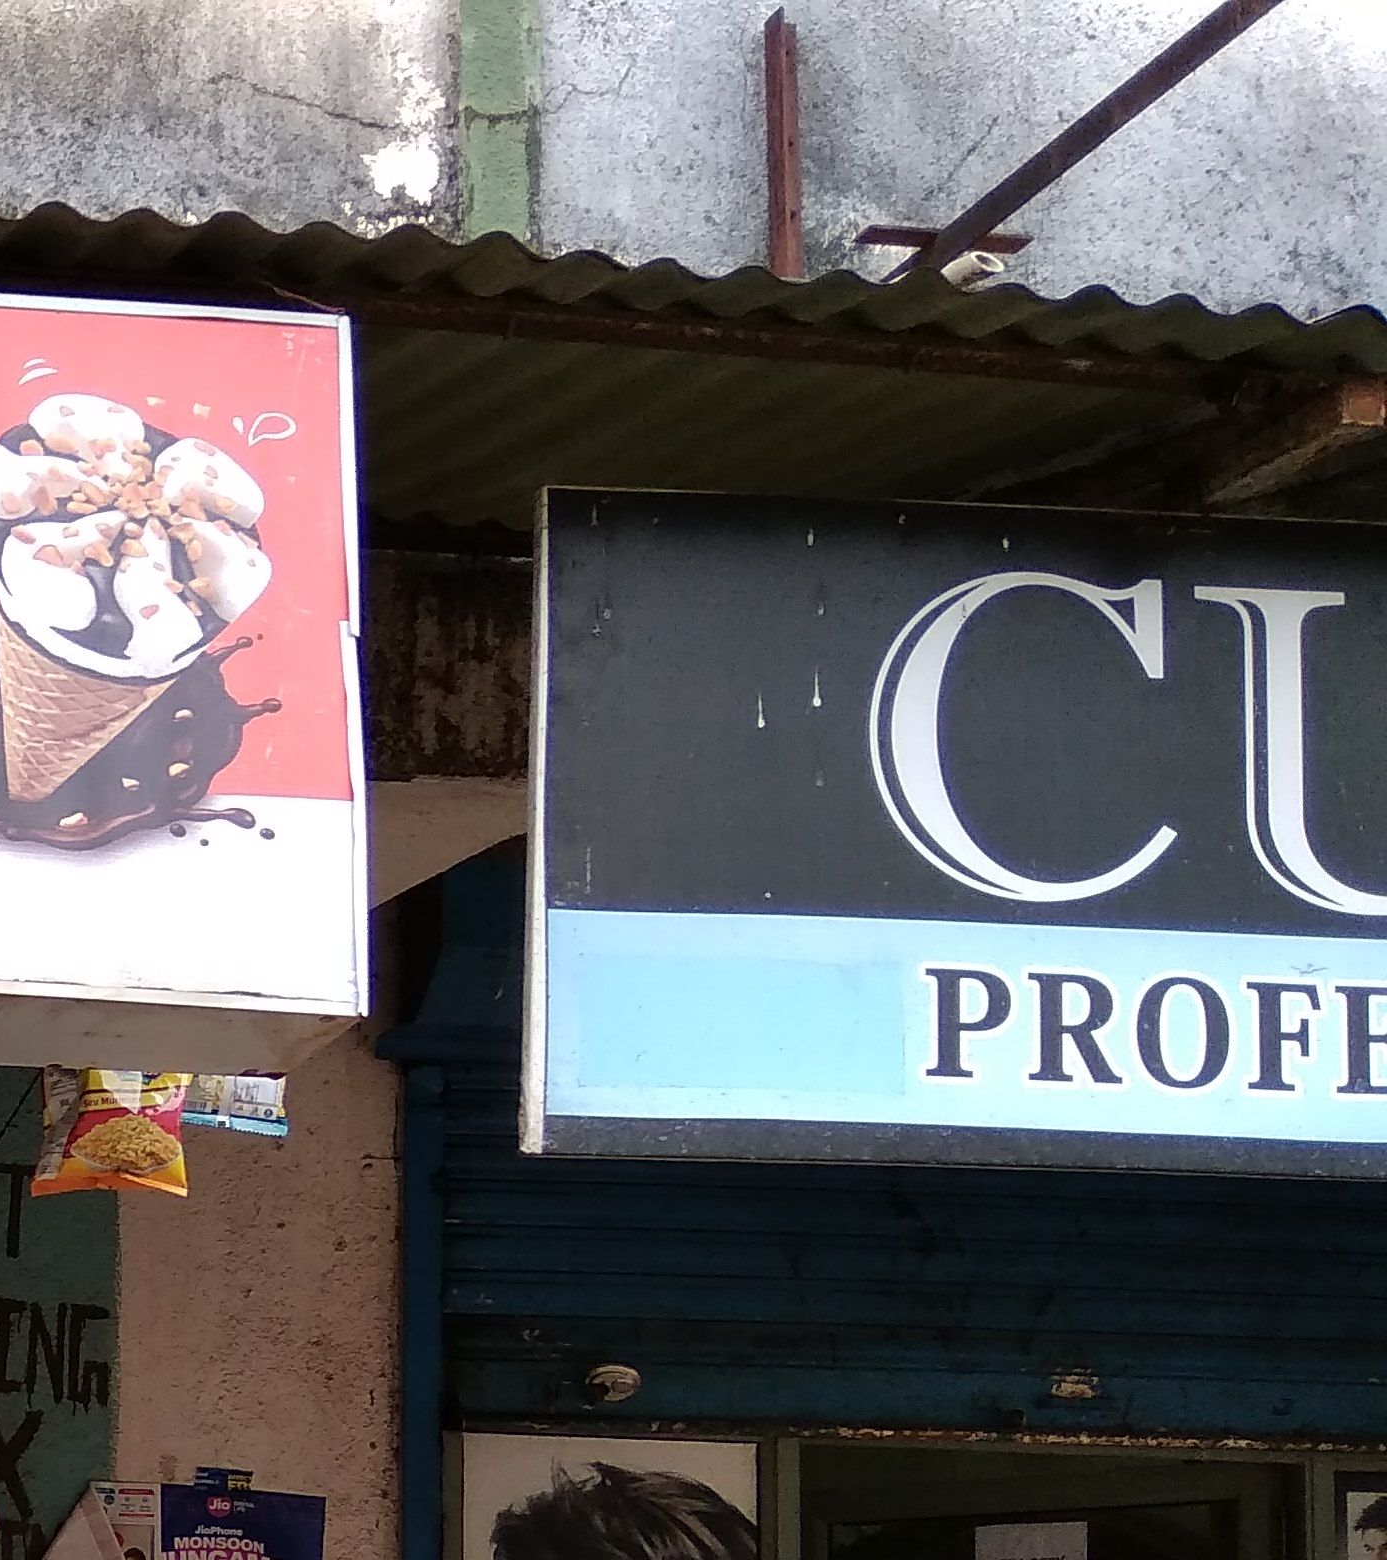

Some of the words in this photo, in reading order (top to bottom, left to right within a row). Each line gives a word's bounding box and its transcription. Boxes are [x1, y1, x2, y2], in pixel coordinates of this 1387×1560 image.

[208, 1498, 230, 1512] Jio
[194, 1524, 244, 1536] JioPhone
[173, 1536, 266, 1555] MONSOON
